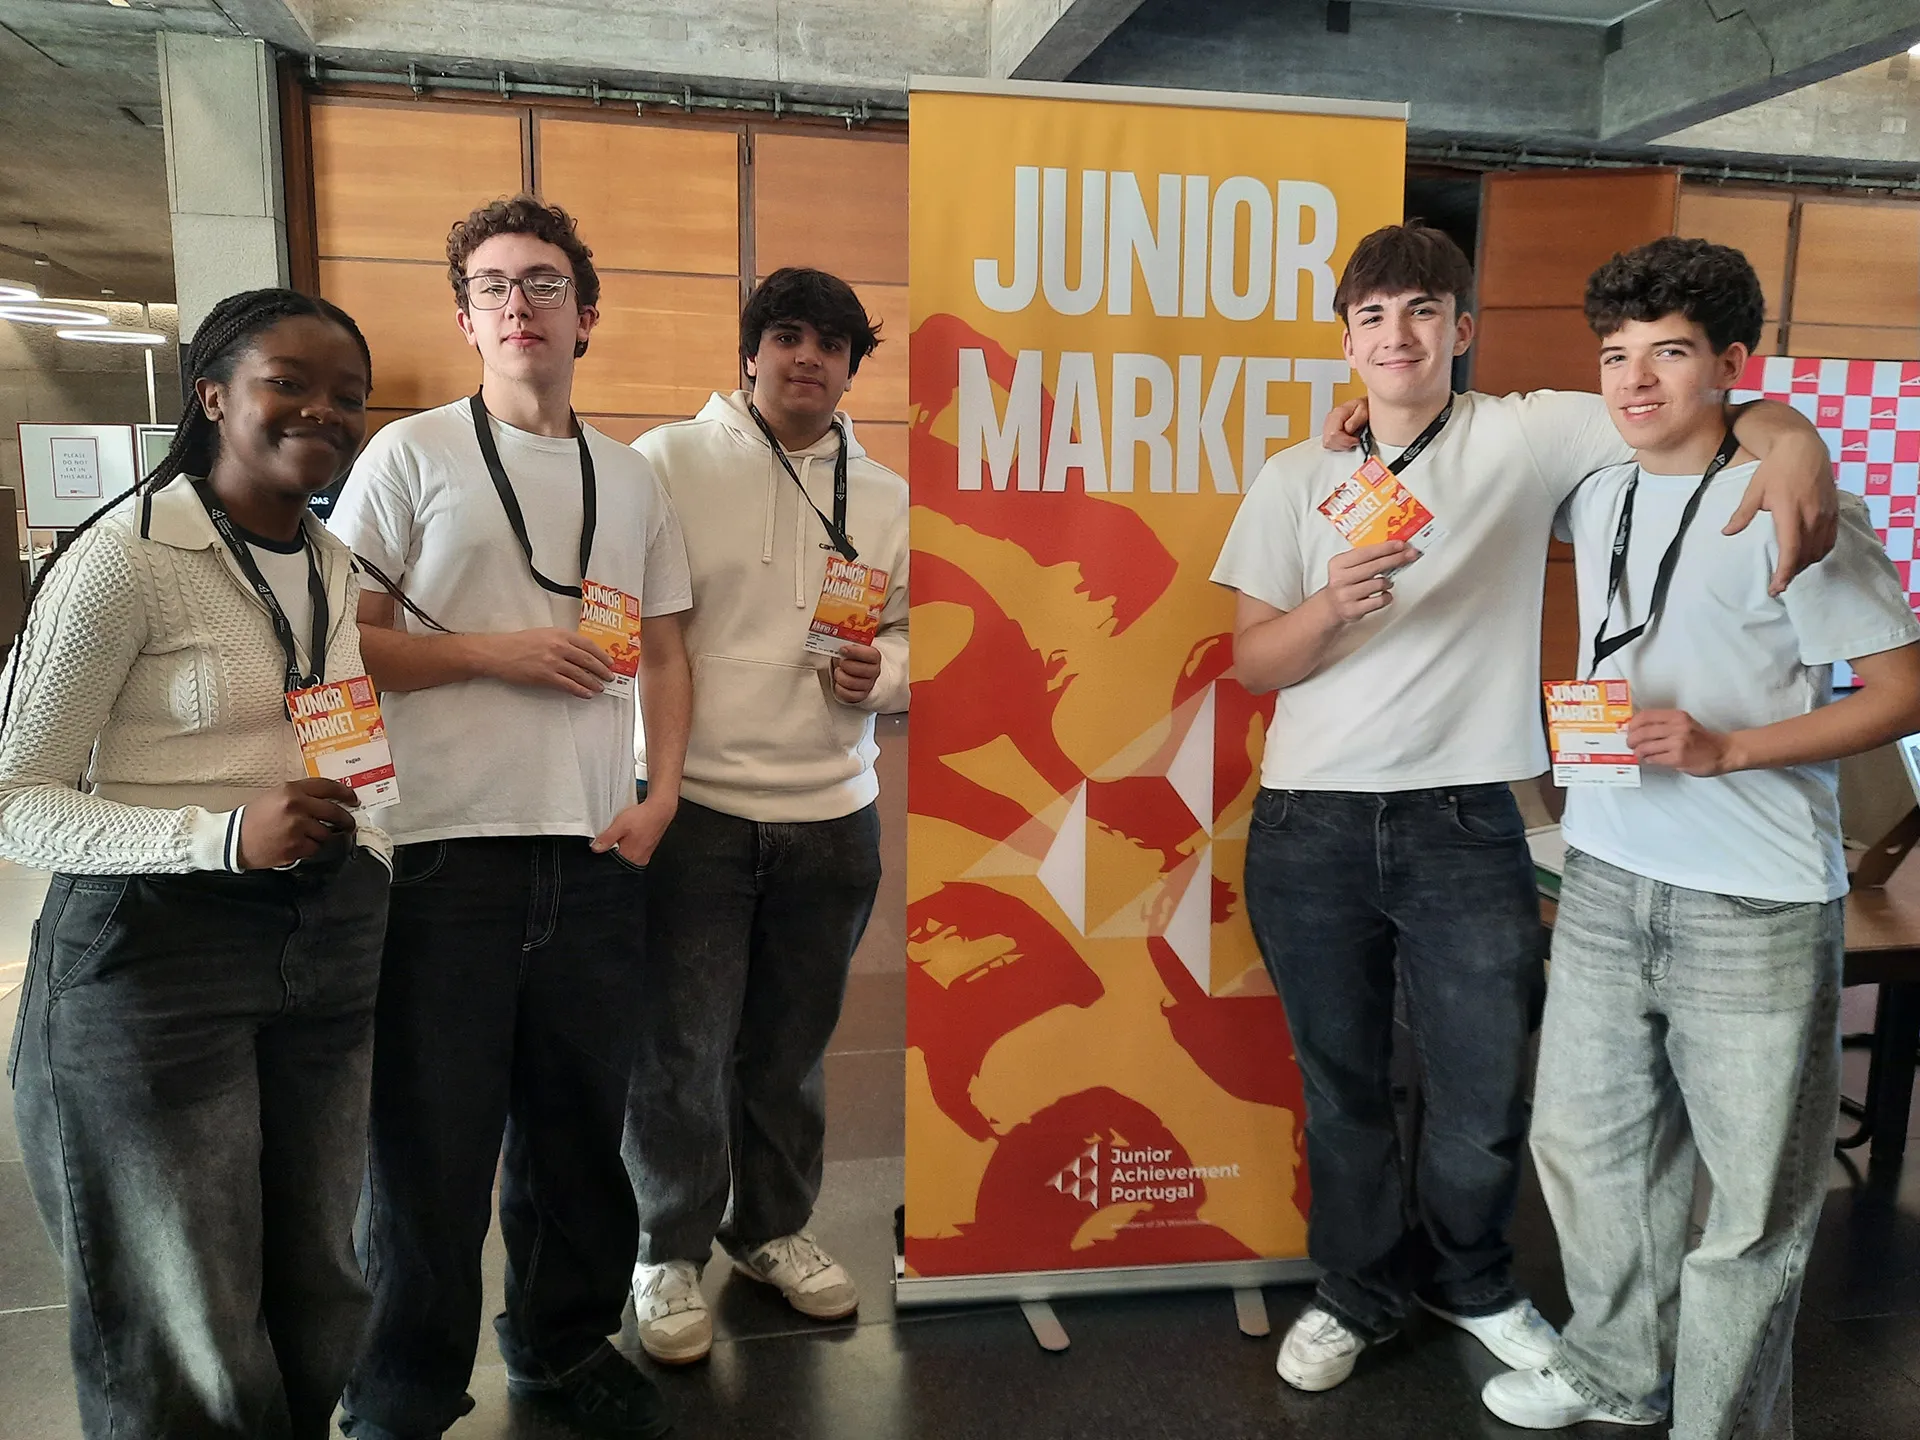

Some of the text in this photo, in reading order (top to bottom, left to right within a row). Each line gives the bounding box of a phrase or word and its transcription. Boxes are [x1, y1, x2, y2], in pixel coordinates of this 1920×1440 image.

[973, 165, 1338, 323] JUNIOR
[957, 347, 1351, 494] MARKET
[309, 496, 330, 505] DAS
[828, 561, 866, 583] JUNIOR
[584, 585, 621, 610] JUNIOR
[823, 578, 866, 602] MARKET
[583, 602, 623, 629] MARKET
[293, 687, 346, 719] JUNIOR
[1549, 684, 1600, 702] JUNIOR
[1550, 704, 1605, 721] MARKET
[296, 711, 356, 744] MARKET
[1110, 1146, 1172, 1164] Junior
[1110, 1162, 1240, 1183] Achievement
[1110, 1182, 1194, 1203] Portugal
